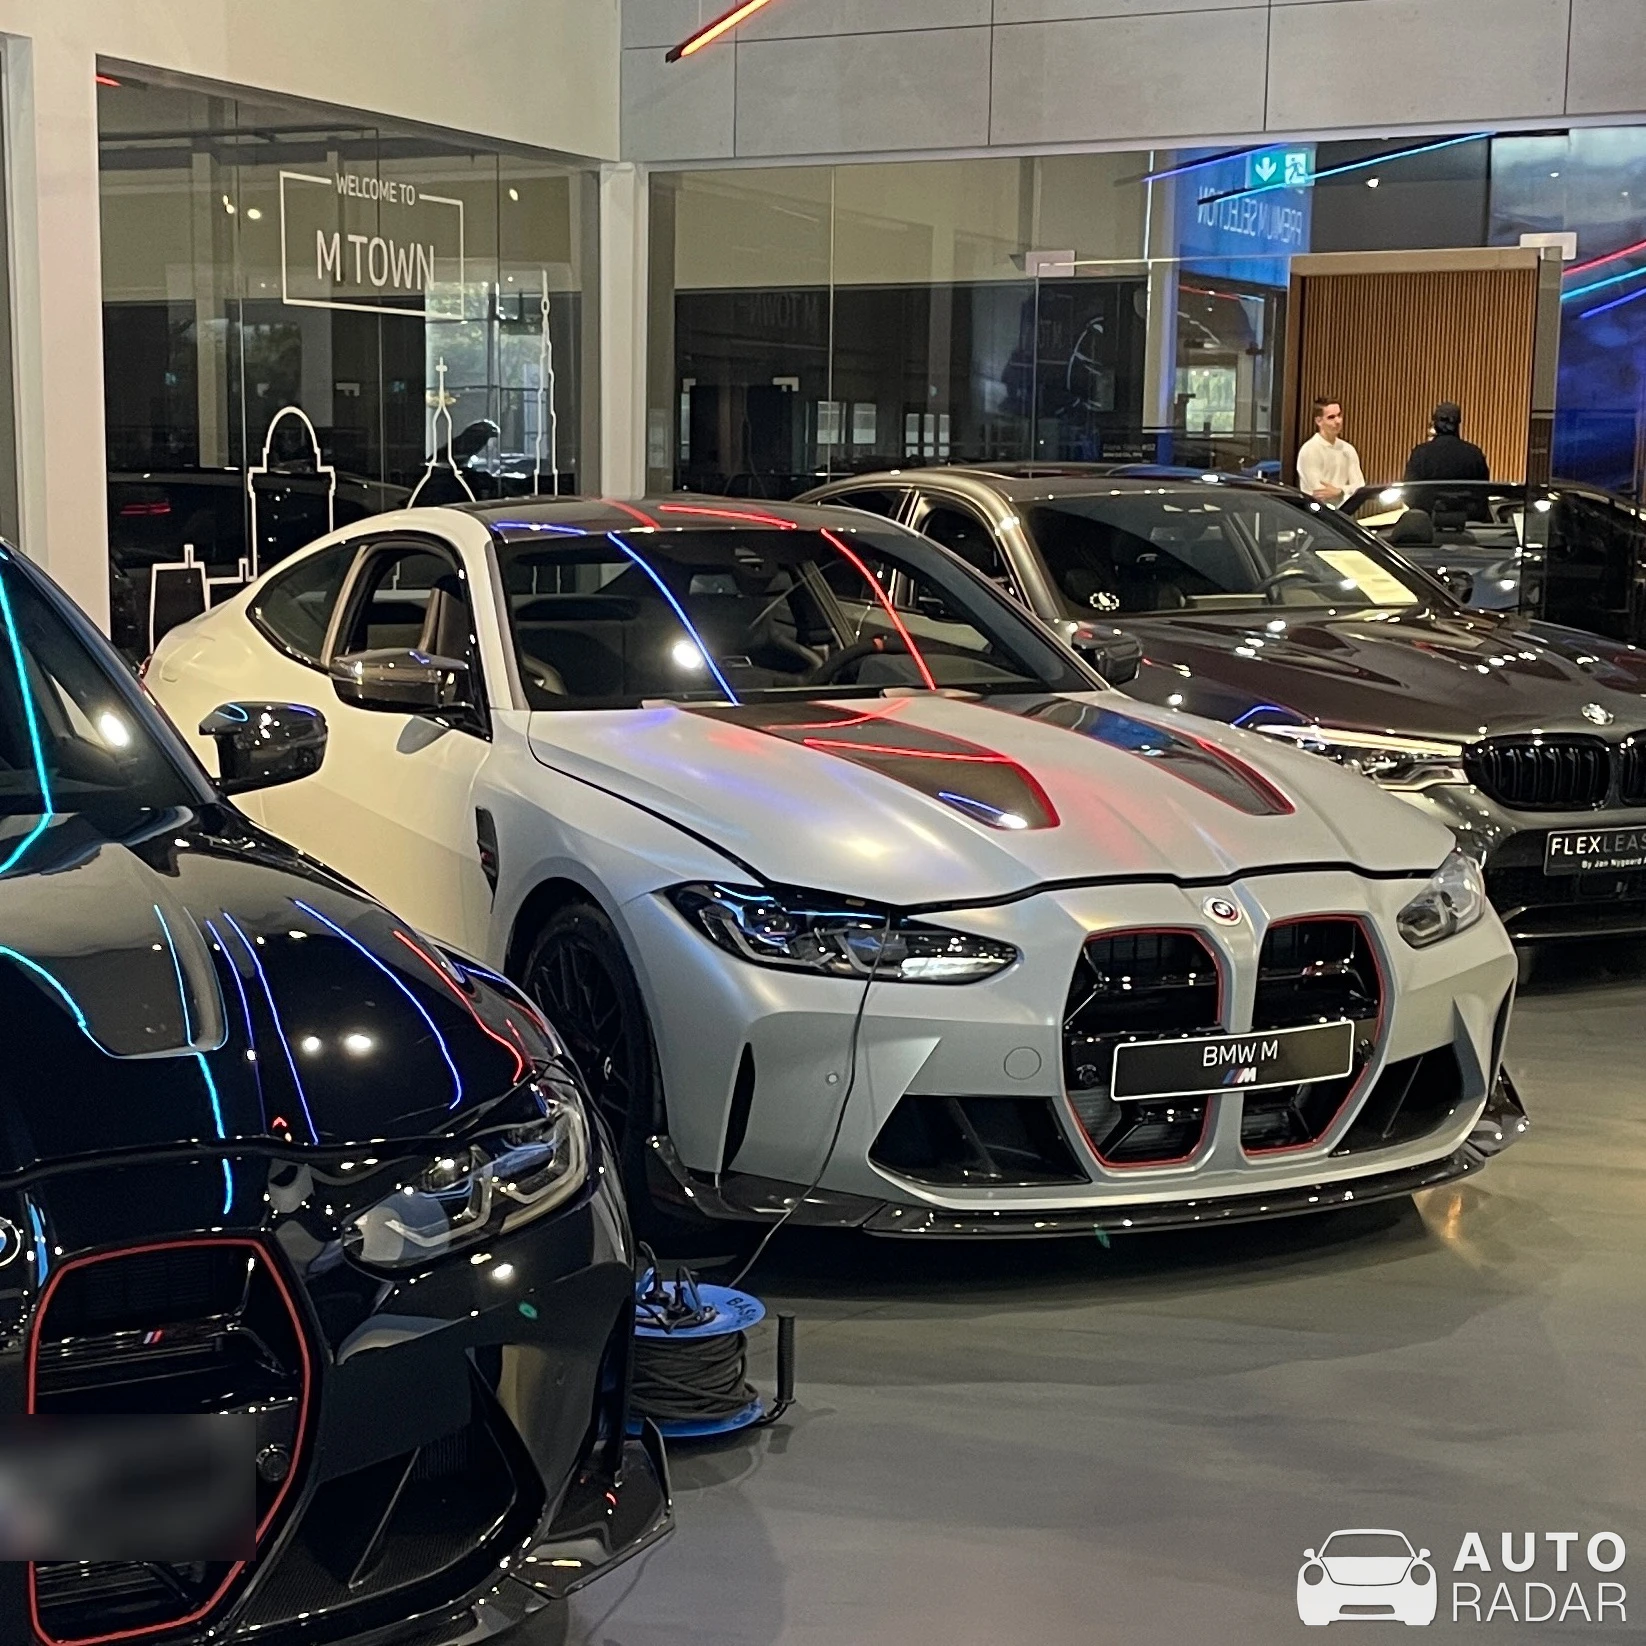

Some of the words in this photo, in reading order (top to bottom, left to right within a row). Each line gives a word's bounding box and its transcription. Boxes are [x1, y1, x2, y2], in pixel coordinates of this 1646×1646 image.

[336, 172, 397, 203] WELCOME
[399, 183, 416, 206] TO
[316, 230, 341, 282] M
[347, 234, 435, 291] TOWN
[1581, 860, 1592, 870] By
[1202, 1042, 1257, 1067] BMW
[1260, 1040, 1279, 1061] M
